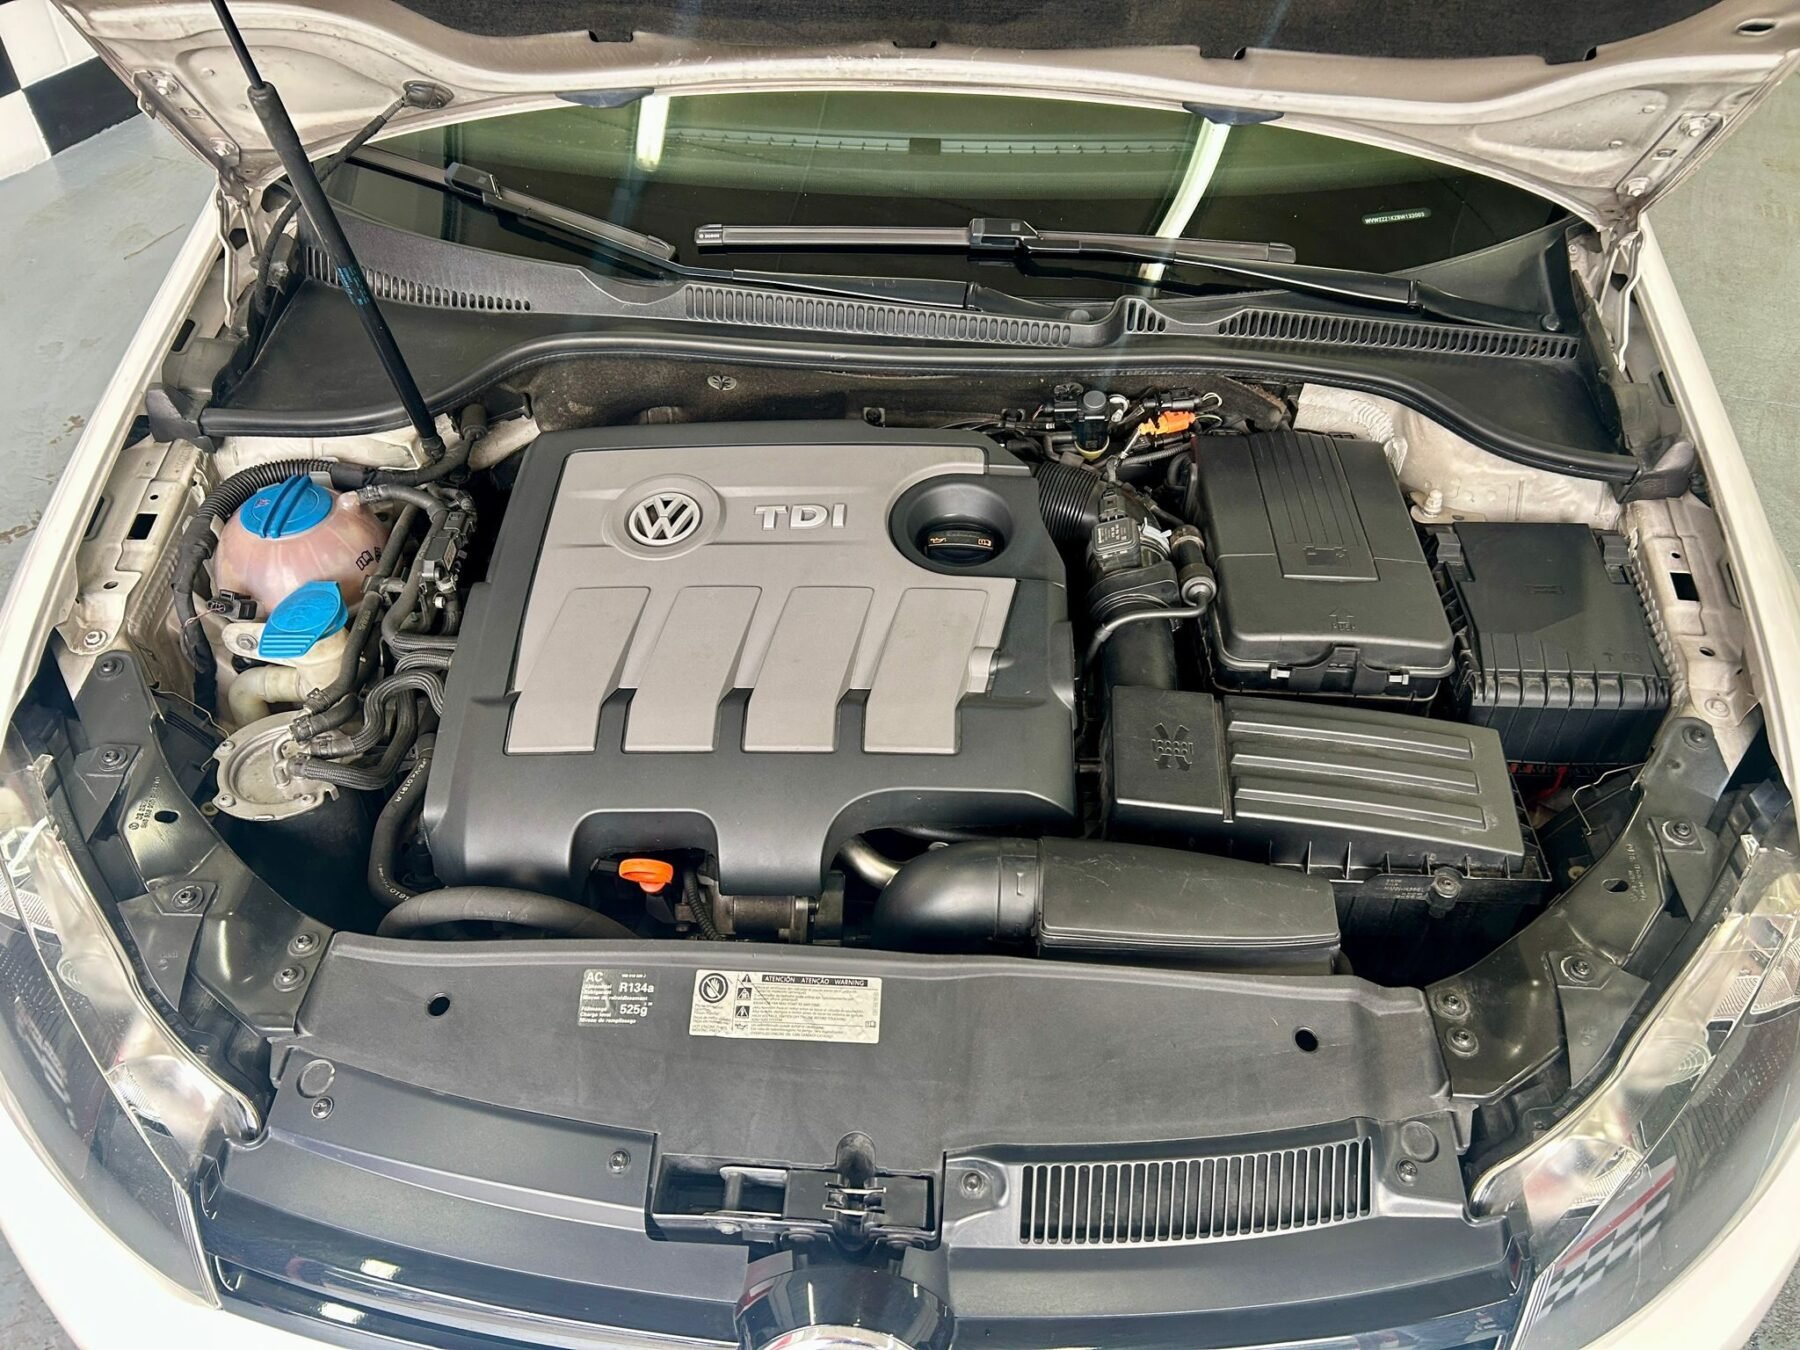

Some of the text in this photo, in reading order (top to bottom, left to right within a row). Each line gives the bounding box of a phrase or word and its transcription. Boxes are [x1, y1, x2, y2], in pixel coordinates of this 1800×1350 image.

[754, 503, 847, 531] TDI
[585, 971, 604, 983] AC
[801, 976, 830, 985] ATENÇÃO
[834, 979, 866, 987] WARNING
[619, 982, 655, 993] R134a
[619, 1003, 648, 1017] 525g
